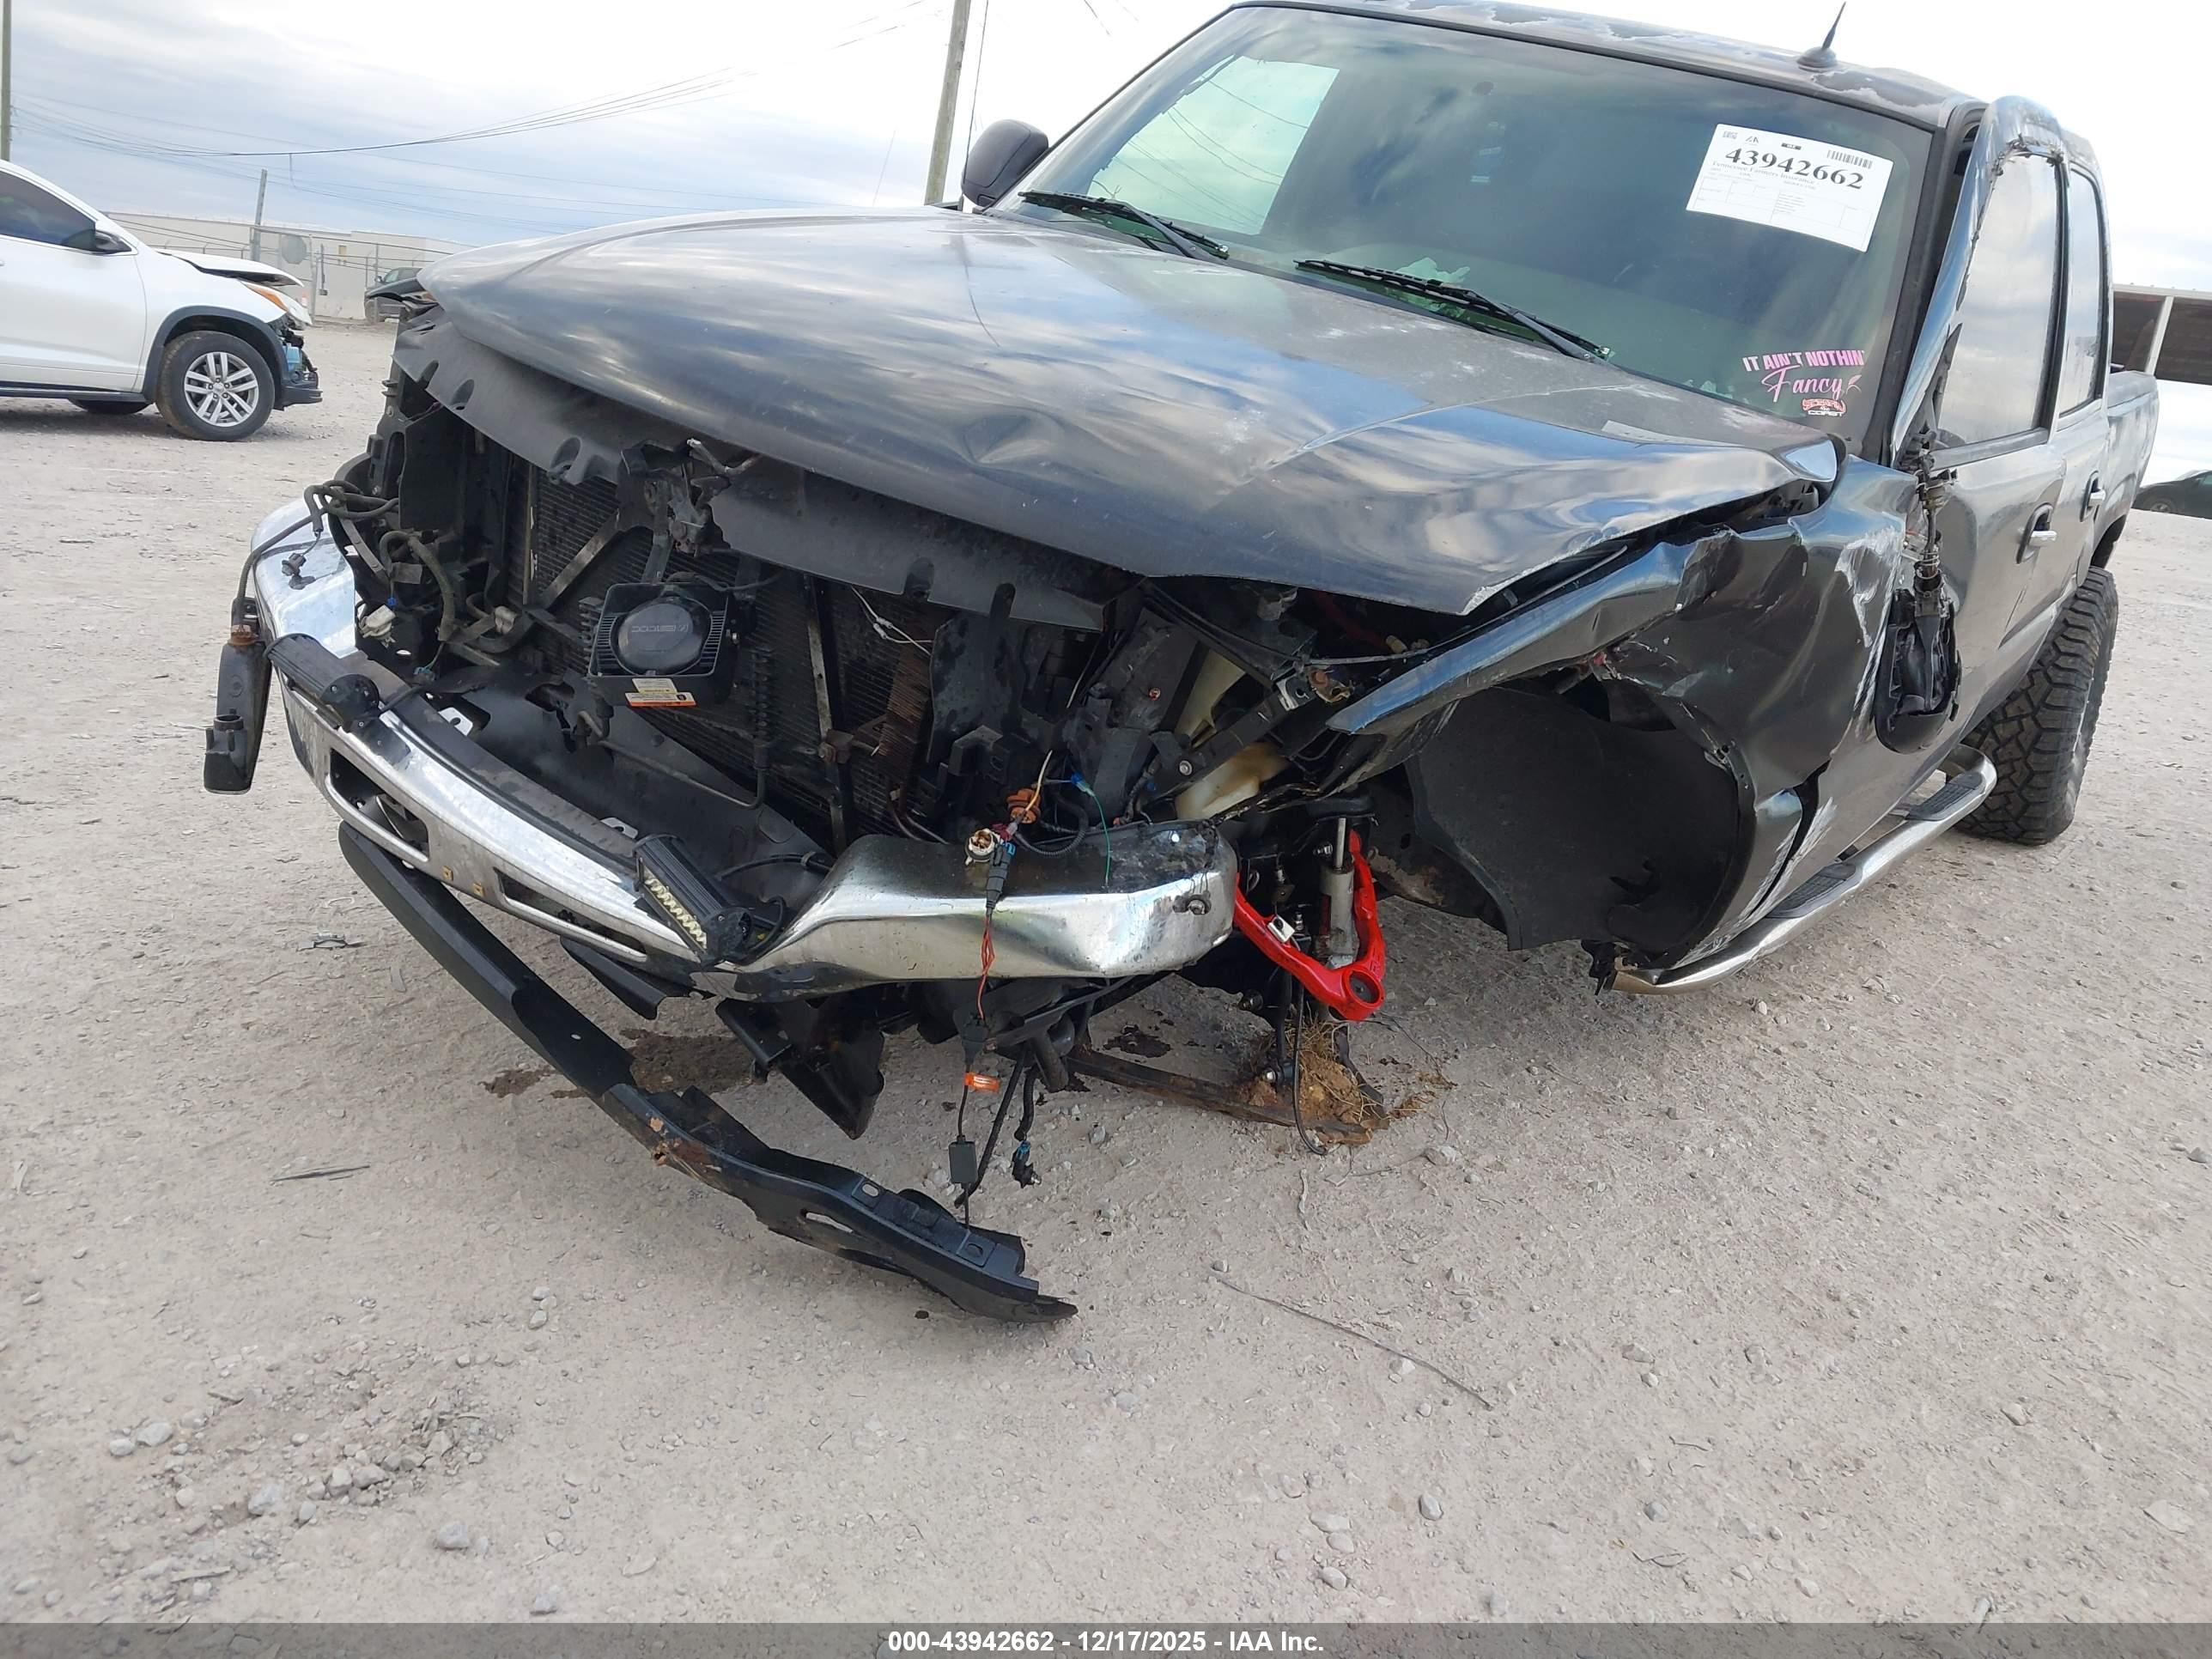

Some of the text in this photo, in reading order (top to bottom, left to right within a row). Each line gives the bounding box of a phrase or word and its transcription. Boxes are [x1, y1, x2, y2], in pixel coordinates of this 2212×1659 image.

[1724, 148, 1864, 190] 43942662
[1742, 356, 1760, 372] IT
[1762, 351, 1803, 370] AIN'T
[1761, 364, 1844, 403] Fancy
